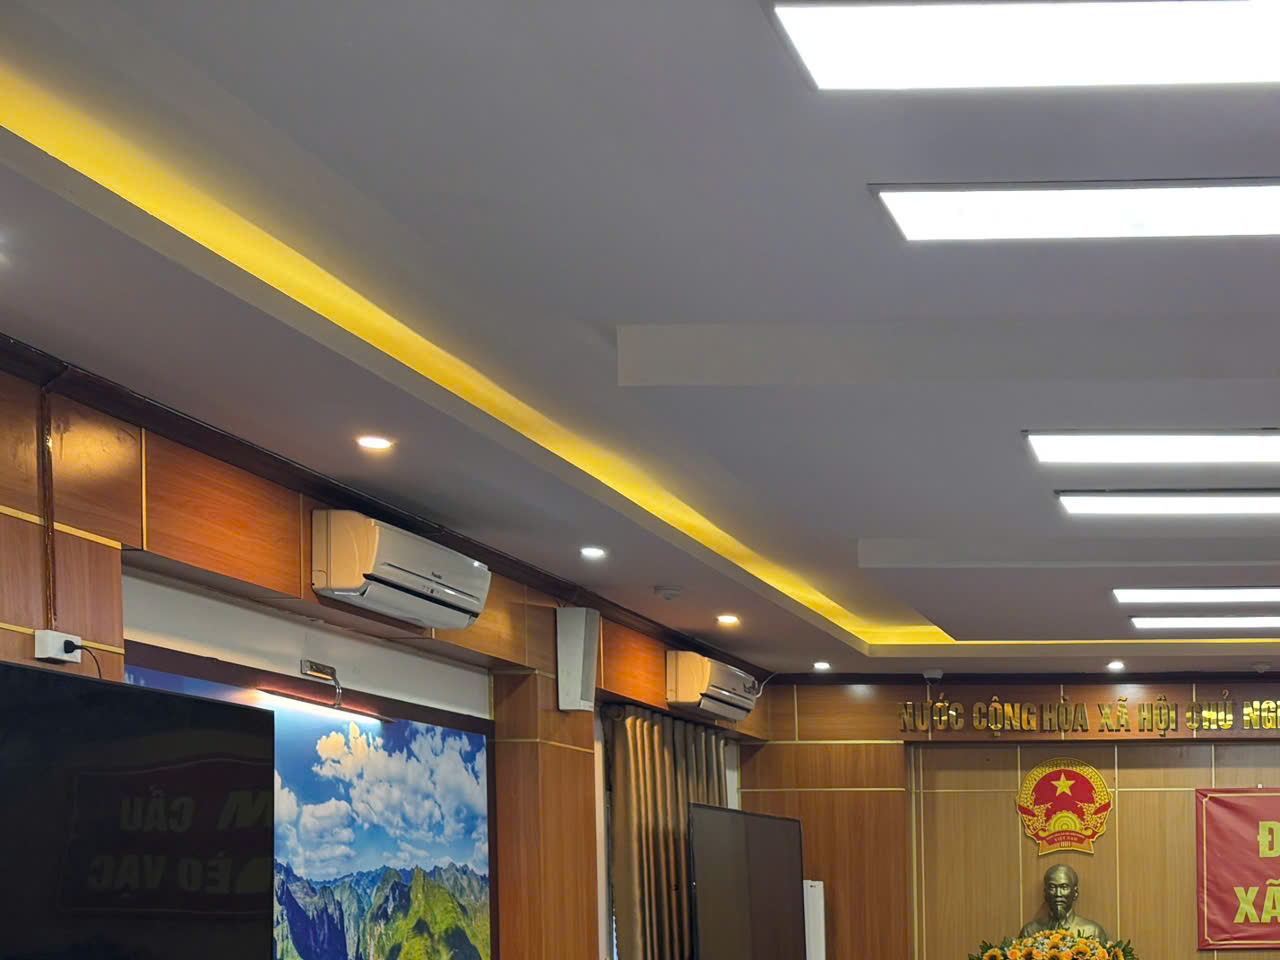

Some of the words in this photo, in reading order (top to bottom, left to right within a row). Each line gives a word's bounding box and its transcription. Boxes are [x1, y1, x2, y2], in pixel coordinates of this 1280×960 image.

[901, 691, 964, 733] NƯỚC
[973, 696, 1037, 737] CỘNG
[1042, 697, 1090, 732] HÒA
[1097, 697, 1130, 732] XÃ
[1138, 695, 1178, 737] HỘI
[1186, 690, 1234, 730] CHỦ
